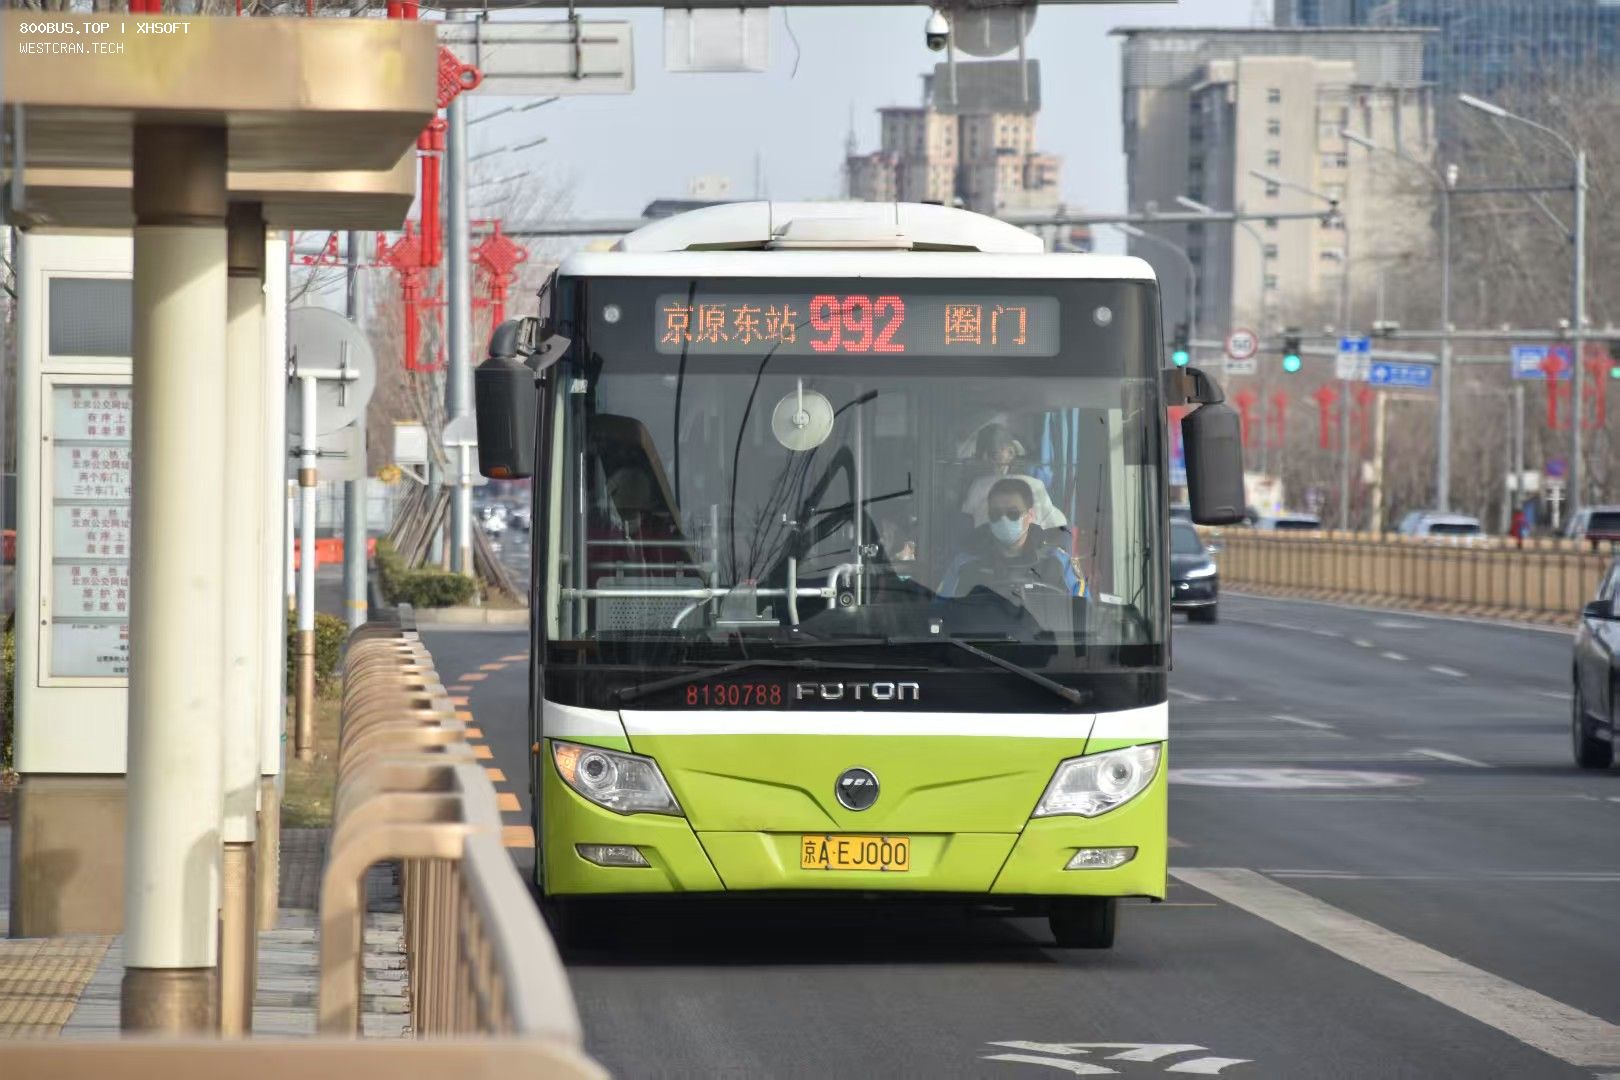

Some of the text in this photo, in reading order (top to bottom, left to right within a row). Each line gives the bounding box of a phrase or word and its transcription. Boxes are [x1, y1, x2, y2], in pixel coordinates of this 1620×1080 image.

[661, 303, 798, 344] 京原东站
[809, 295, 905, 352] 992
[944, 303, 1027, 345] 圈门
[686, 684, 782, 705] 8130788
